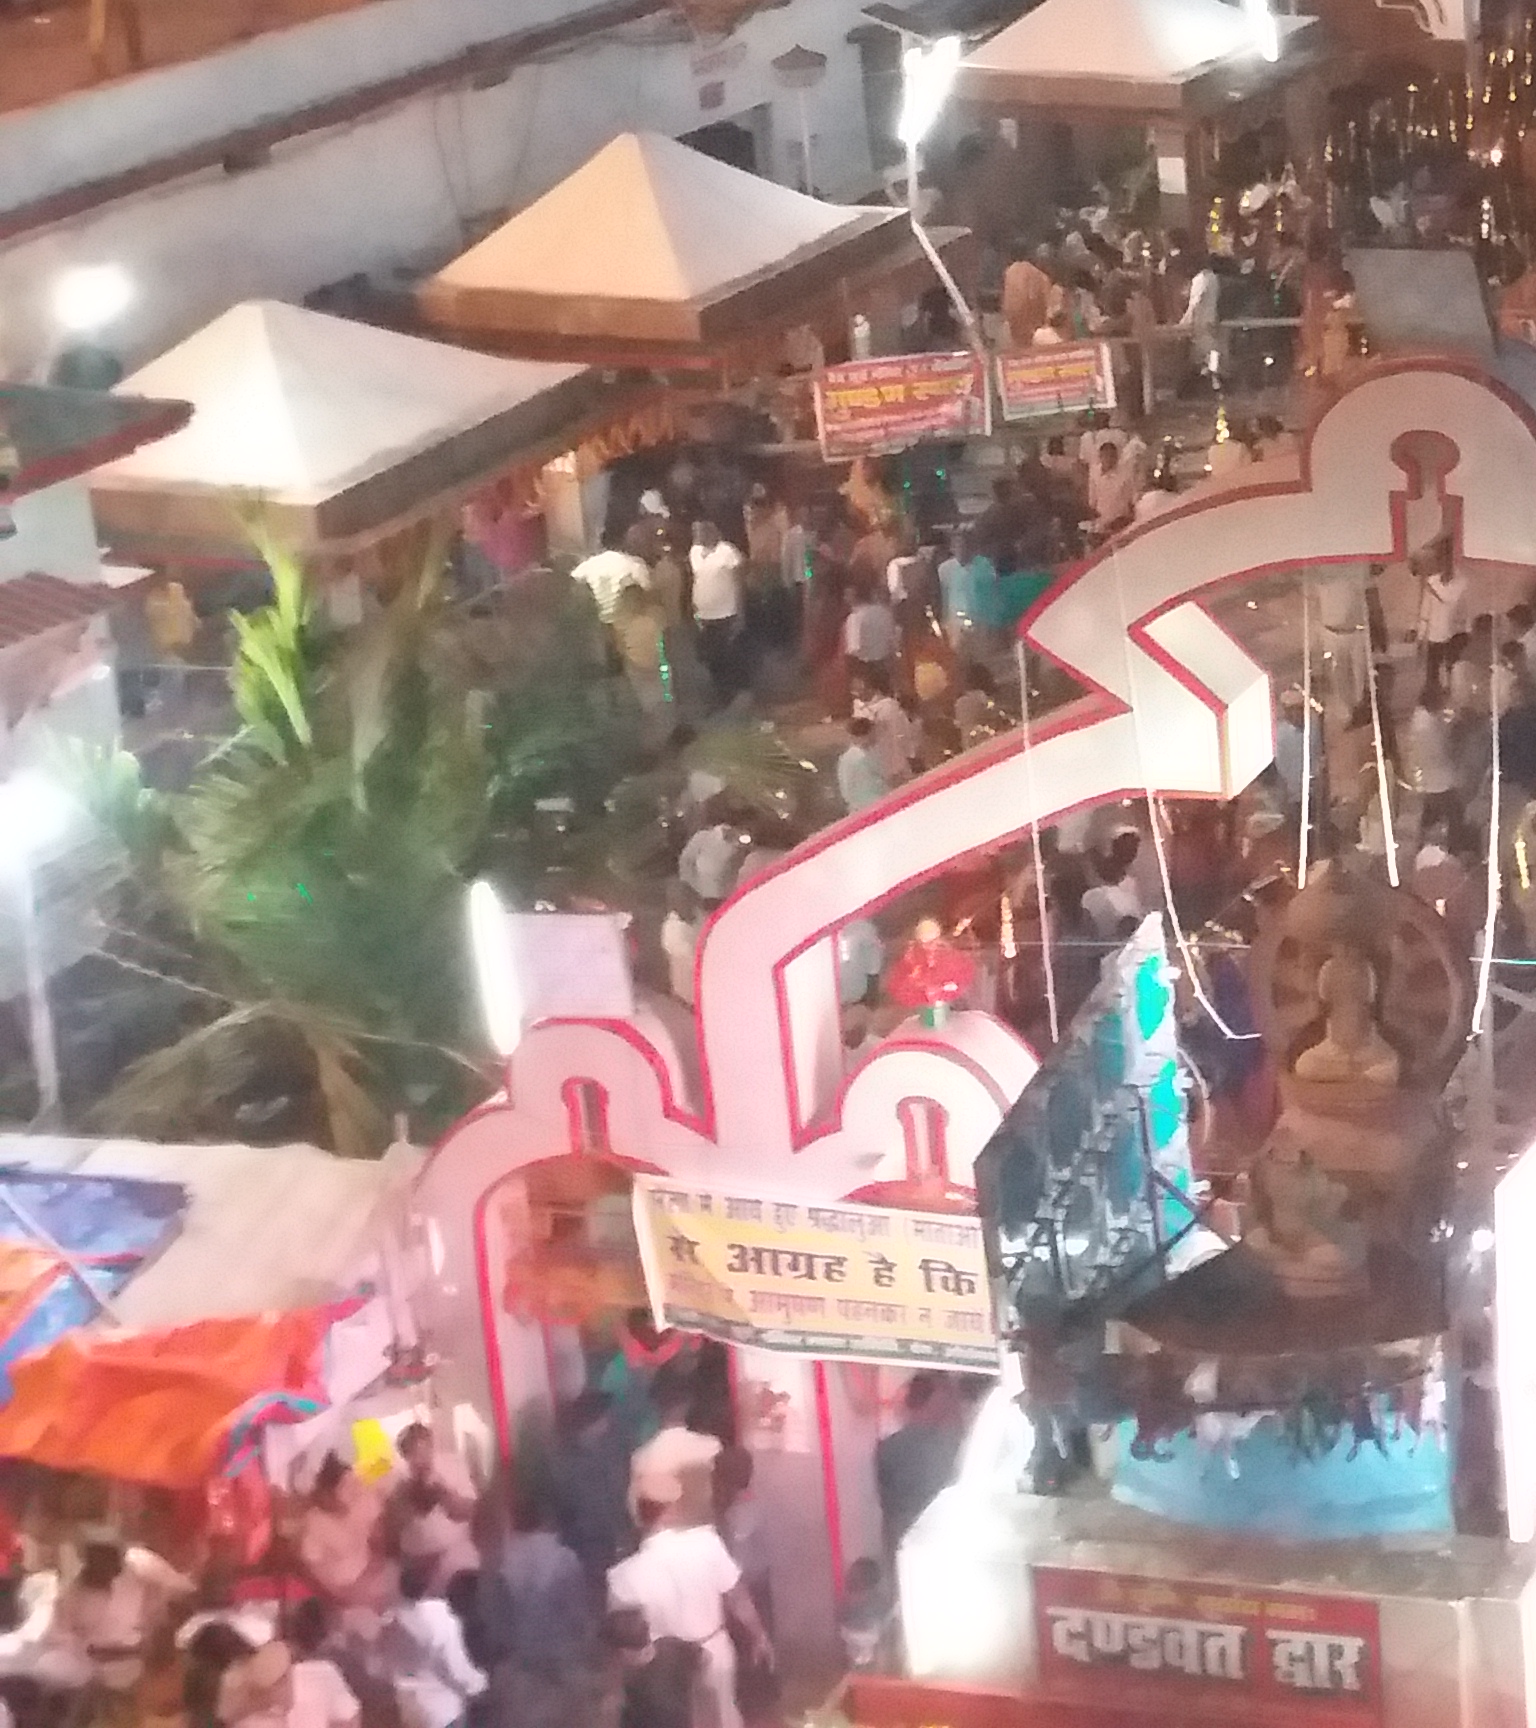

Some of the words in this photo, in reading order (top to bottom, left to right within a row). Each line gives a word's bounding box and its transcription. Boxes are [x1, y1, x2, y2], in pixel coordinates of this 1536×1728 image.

[727, 1242, 848, 1282] आग्रह
[863, 1250, 897, 1288] है
[918, 1257, 979, 1296] कि
[1046, 1605, 1249, 1680] दण्डवत
[1265, 1628, 1366, 1691] द्वार
